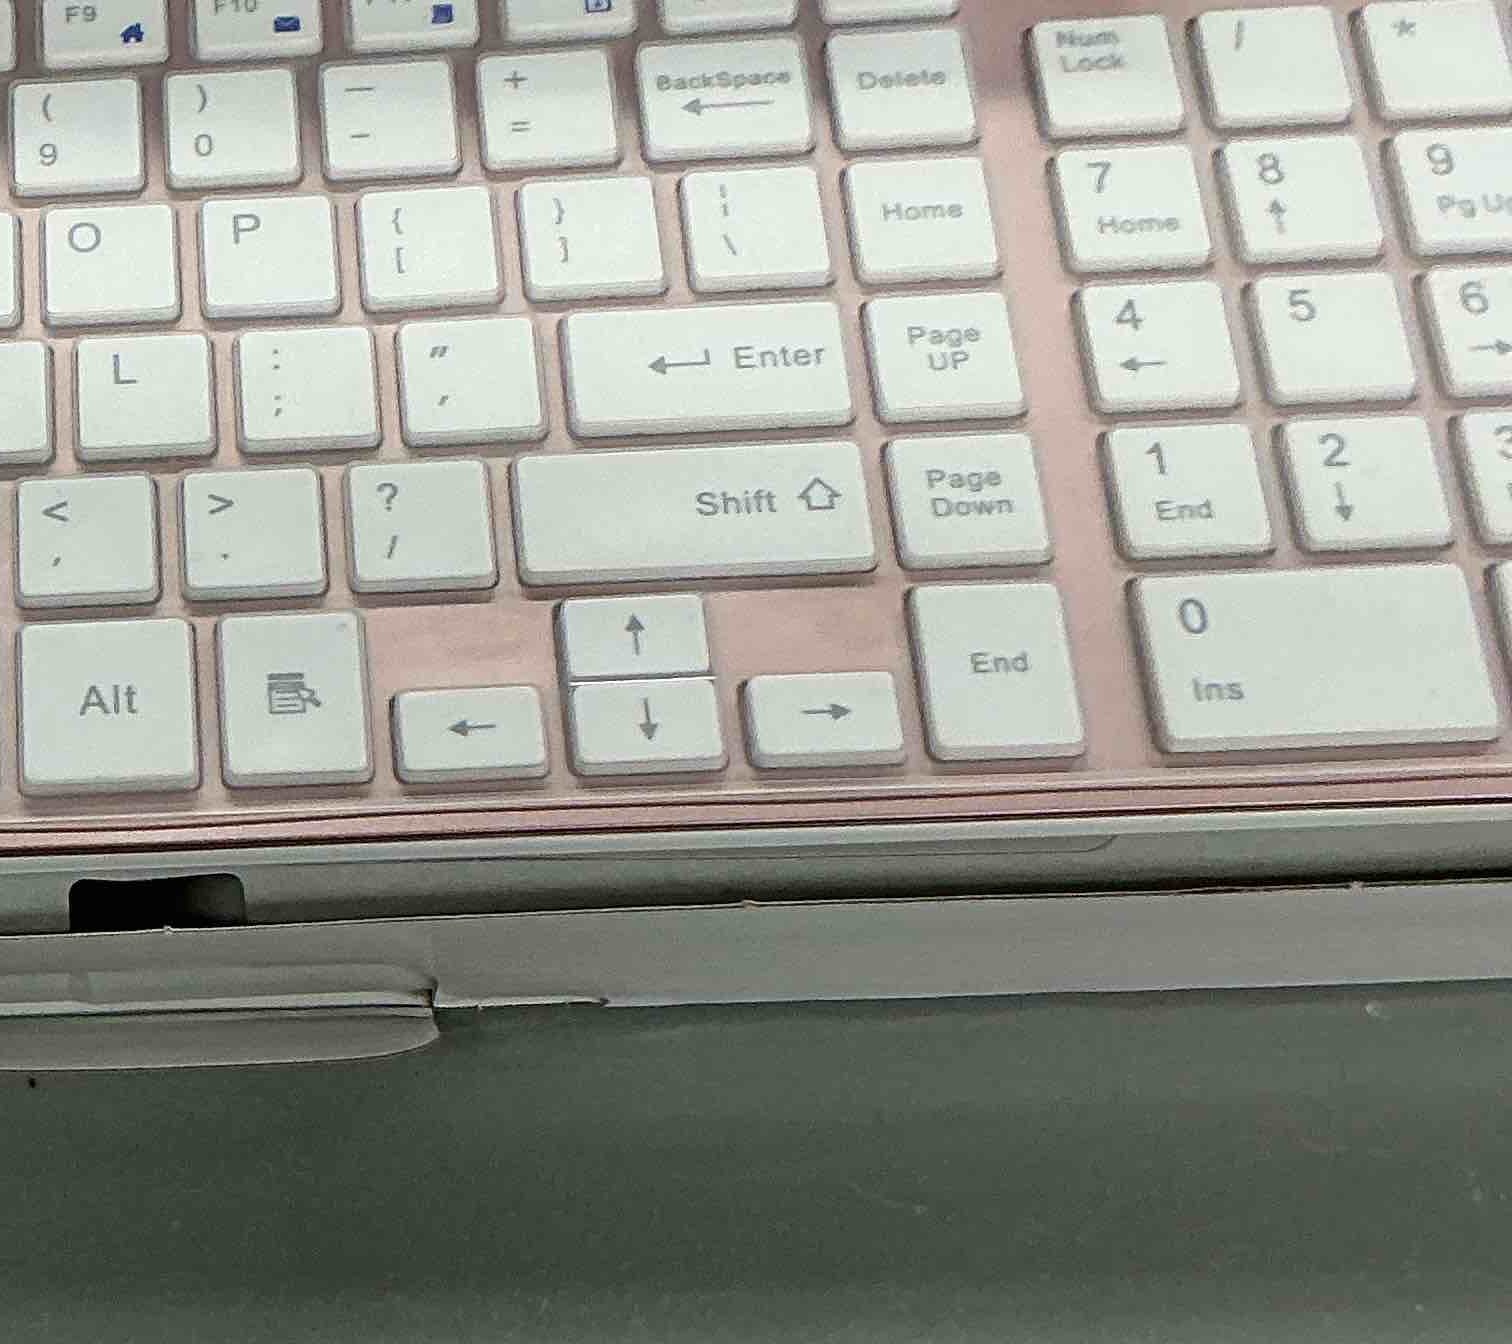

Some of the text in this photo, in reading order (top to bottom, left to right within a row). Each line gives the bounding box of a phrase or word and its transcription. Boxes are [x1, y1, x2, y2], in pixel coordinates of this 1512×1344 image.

[64, 5, 98, 24] F9
[1058, 52, 1127, 74] Lock
[654, 70, 792, 92] BackSpace
[855, 68, 947, 91] Delete
[38, 142, 59, 167] 9
[193, 133, 214, 158] 0
[1255, 152, 1286, 186] 8
[1425, 142, 1455, 176] 9
[1086, 161, 1112, 194] 7
[881, 202, 964, 222] Home
[1436, 194, 1478, 219] Pg
[67, 221, 102, 253] O
[232, 213, 261, 245] P
[1096, 215, 1181, 235] Home
[1287, 288, 1317, 323] 5
[1458, 280, 1490, 316] 6
[1115, 298, 1144, 331] 4
[906, 325, 981, 349] Page
[112, 353, 138, 385] L
[733, 345, 826, 370] Enter
[927, 349, 970, 372] UP
[1145, 441, 1167, 476] 1
[1318, 432, 1351, 468] 2
[924, 468, 1003, 493] Page
[695, 488, 778, 517] Shift
[930, 497, 1014, 519] Down
[1154, 498, 1215, 522] End
[1177, 597, 1209, 635] 0
[969, 651, 1030, 675] End
[79, 684, 138, 717] Alt
[1191, 678, 1245, 702] Ins
